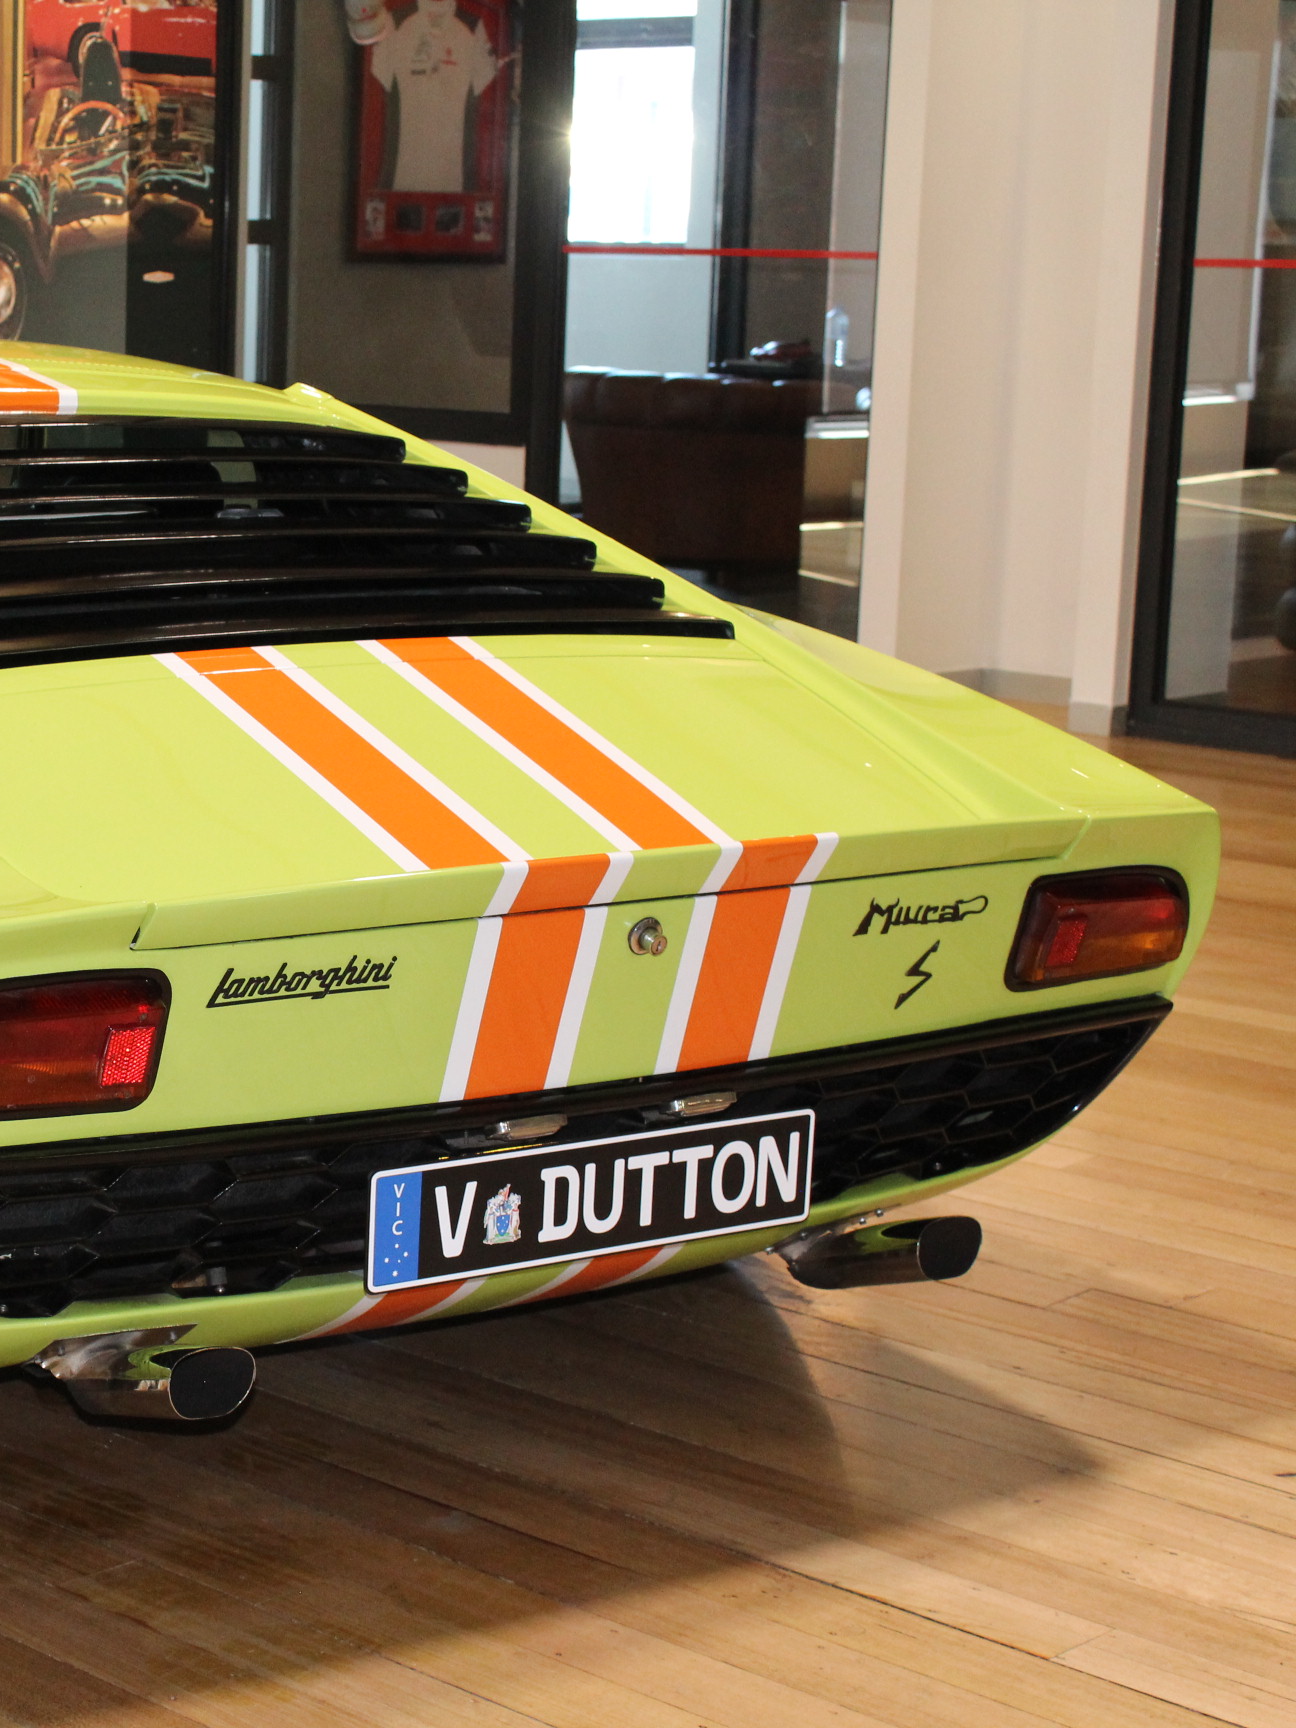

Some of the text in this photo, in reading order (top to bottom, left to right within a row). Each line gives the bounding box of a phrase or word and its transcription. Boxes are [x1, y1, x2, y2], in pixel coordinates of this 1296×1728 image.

[852, 895, 989, 937] Miura
[205, 954, 398, 1008] Lamborghini
[391, 1182, 406, 1236] VIC
[434, 1130, 801, 1259] V DUTTON
